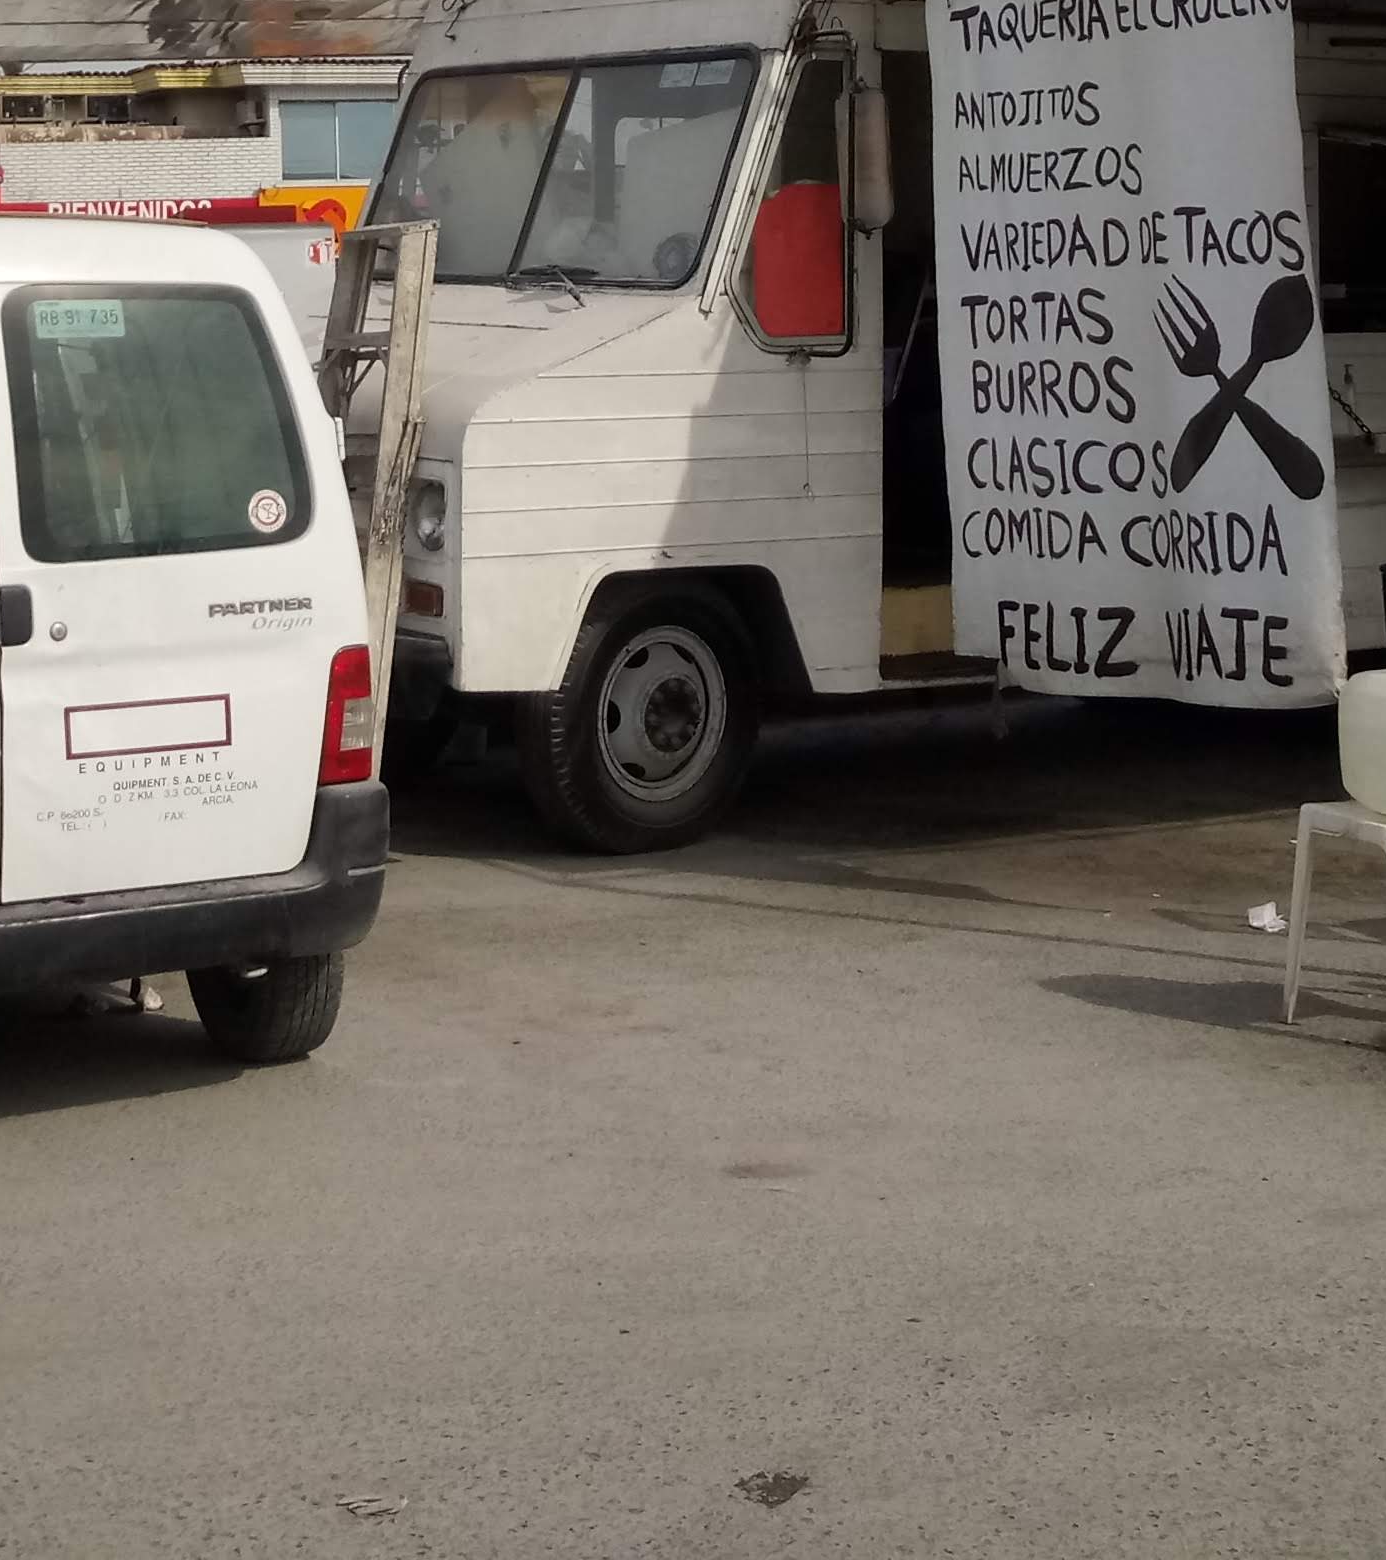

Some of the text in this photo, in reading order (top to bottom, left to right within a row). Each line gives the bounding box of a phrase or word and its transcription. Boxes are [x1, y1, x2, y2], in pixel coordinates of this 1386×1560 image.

[955, 81, 1100, 131] ANTOJITOS
[959, 143, 1142, 195] ALMUERZOS
[961, 206, 1305, 272] VARIEDAD DE TACOS
[960, 288, 1114, 349] TORTAS
[972, 356, 1136, 424] BURROS
[967, 438, 1171, 498] CLASICOS
[962, 504, 1288, 576] COMIDA CORRIDA
[209, 597, 312, 618] PARTNER
[252, 616, 312, 631] Origin
[997, 601, 1294, 687] FELIZ VIAJE
